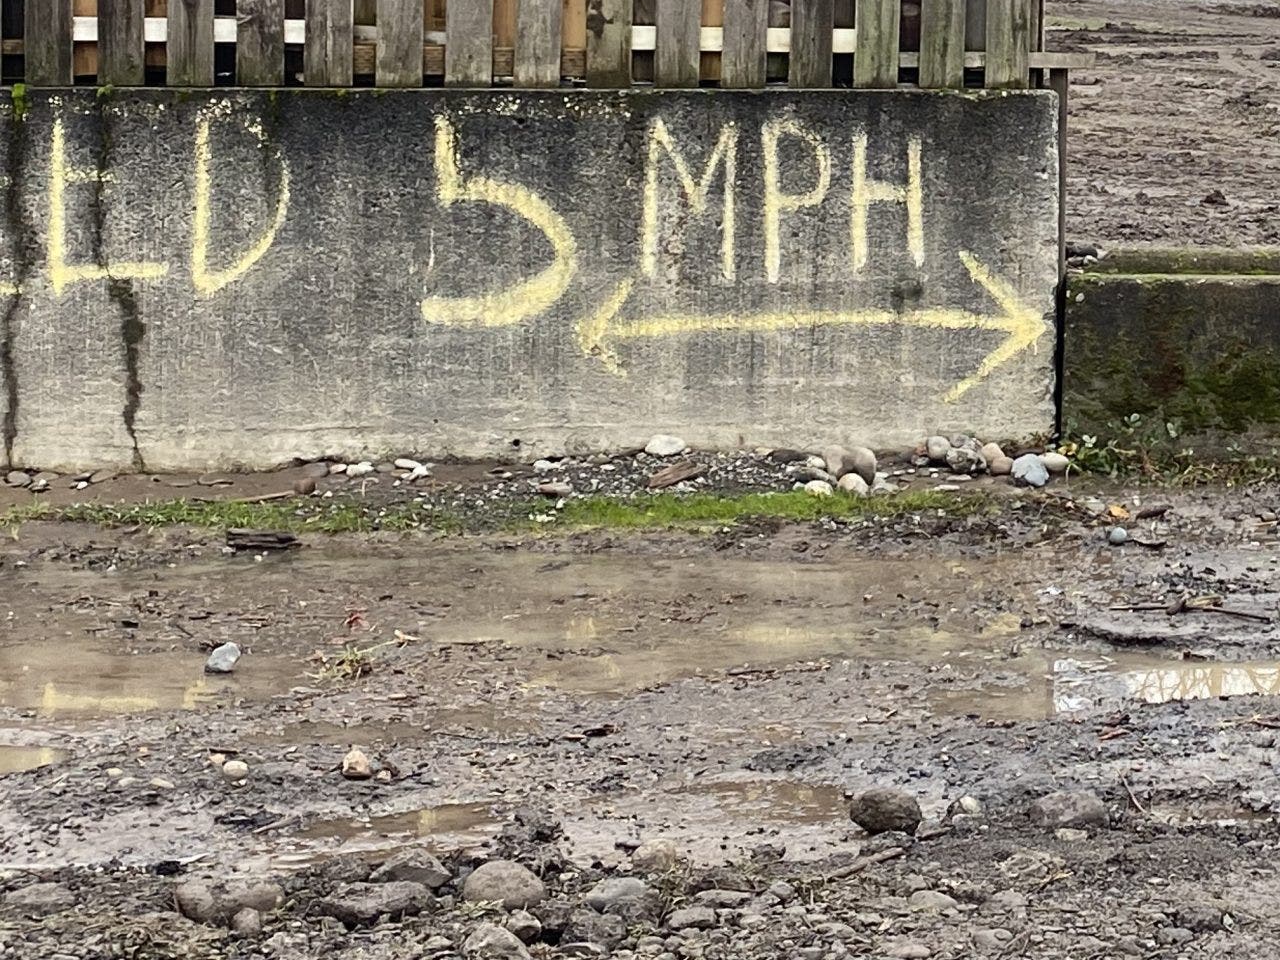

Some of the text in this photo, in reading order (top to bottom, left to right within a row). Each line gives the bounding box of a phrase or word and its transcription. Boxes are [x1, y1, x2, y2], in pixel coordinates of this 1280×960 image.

[0, 96, 924, 327] ED 5 MPH
